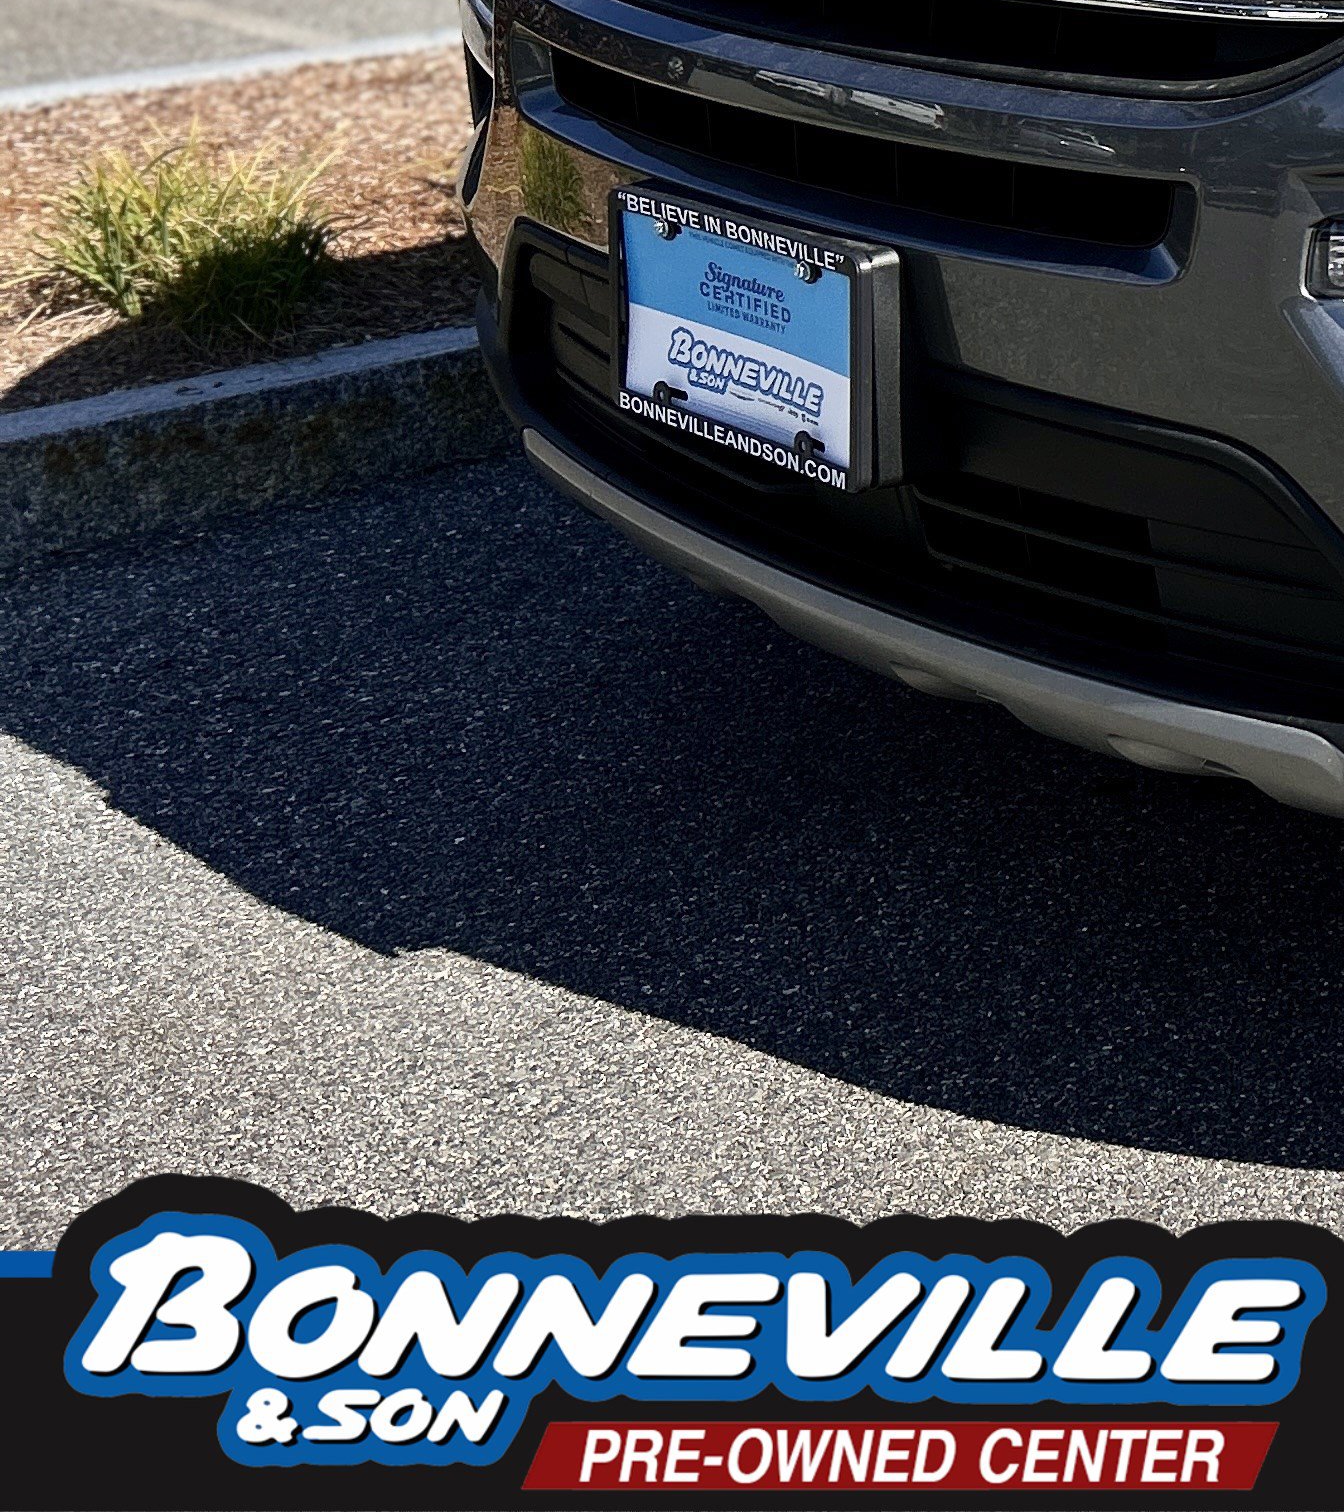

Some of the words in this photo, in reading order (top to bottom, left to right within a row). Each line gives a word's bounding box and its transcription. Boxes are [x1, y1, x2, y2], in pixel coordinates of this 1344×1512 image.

[703, 214, 722, 235] IN
[699, 281, 792, 324] CERTIFIED
[704, 261, 785, 303] Signature
[668, 327, 824, 415] BONNEVILLE
[618, 391, 847, 490] BONNEVILLEANDSON.COM
